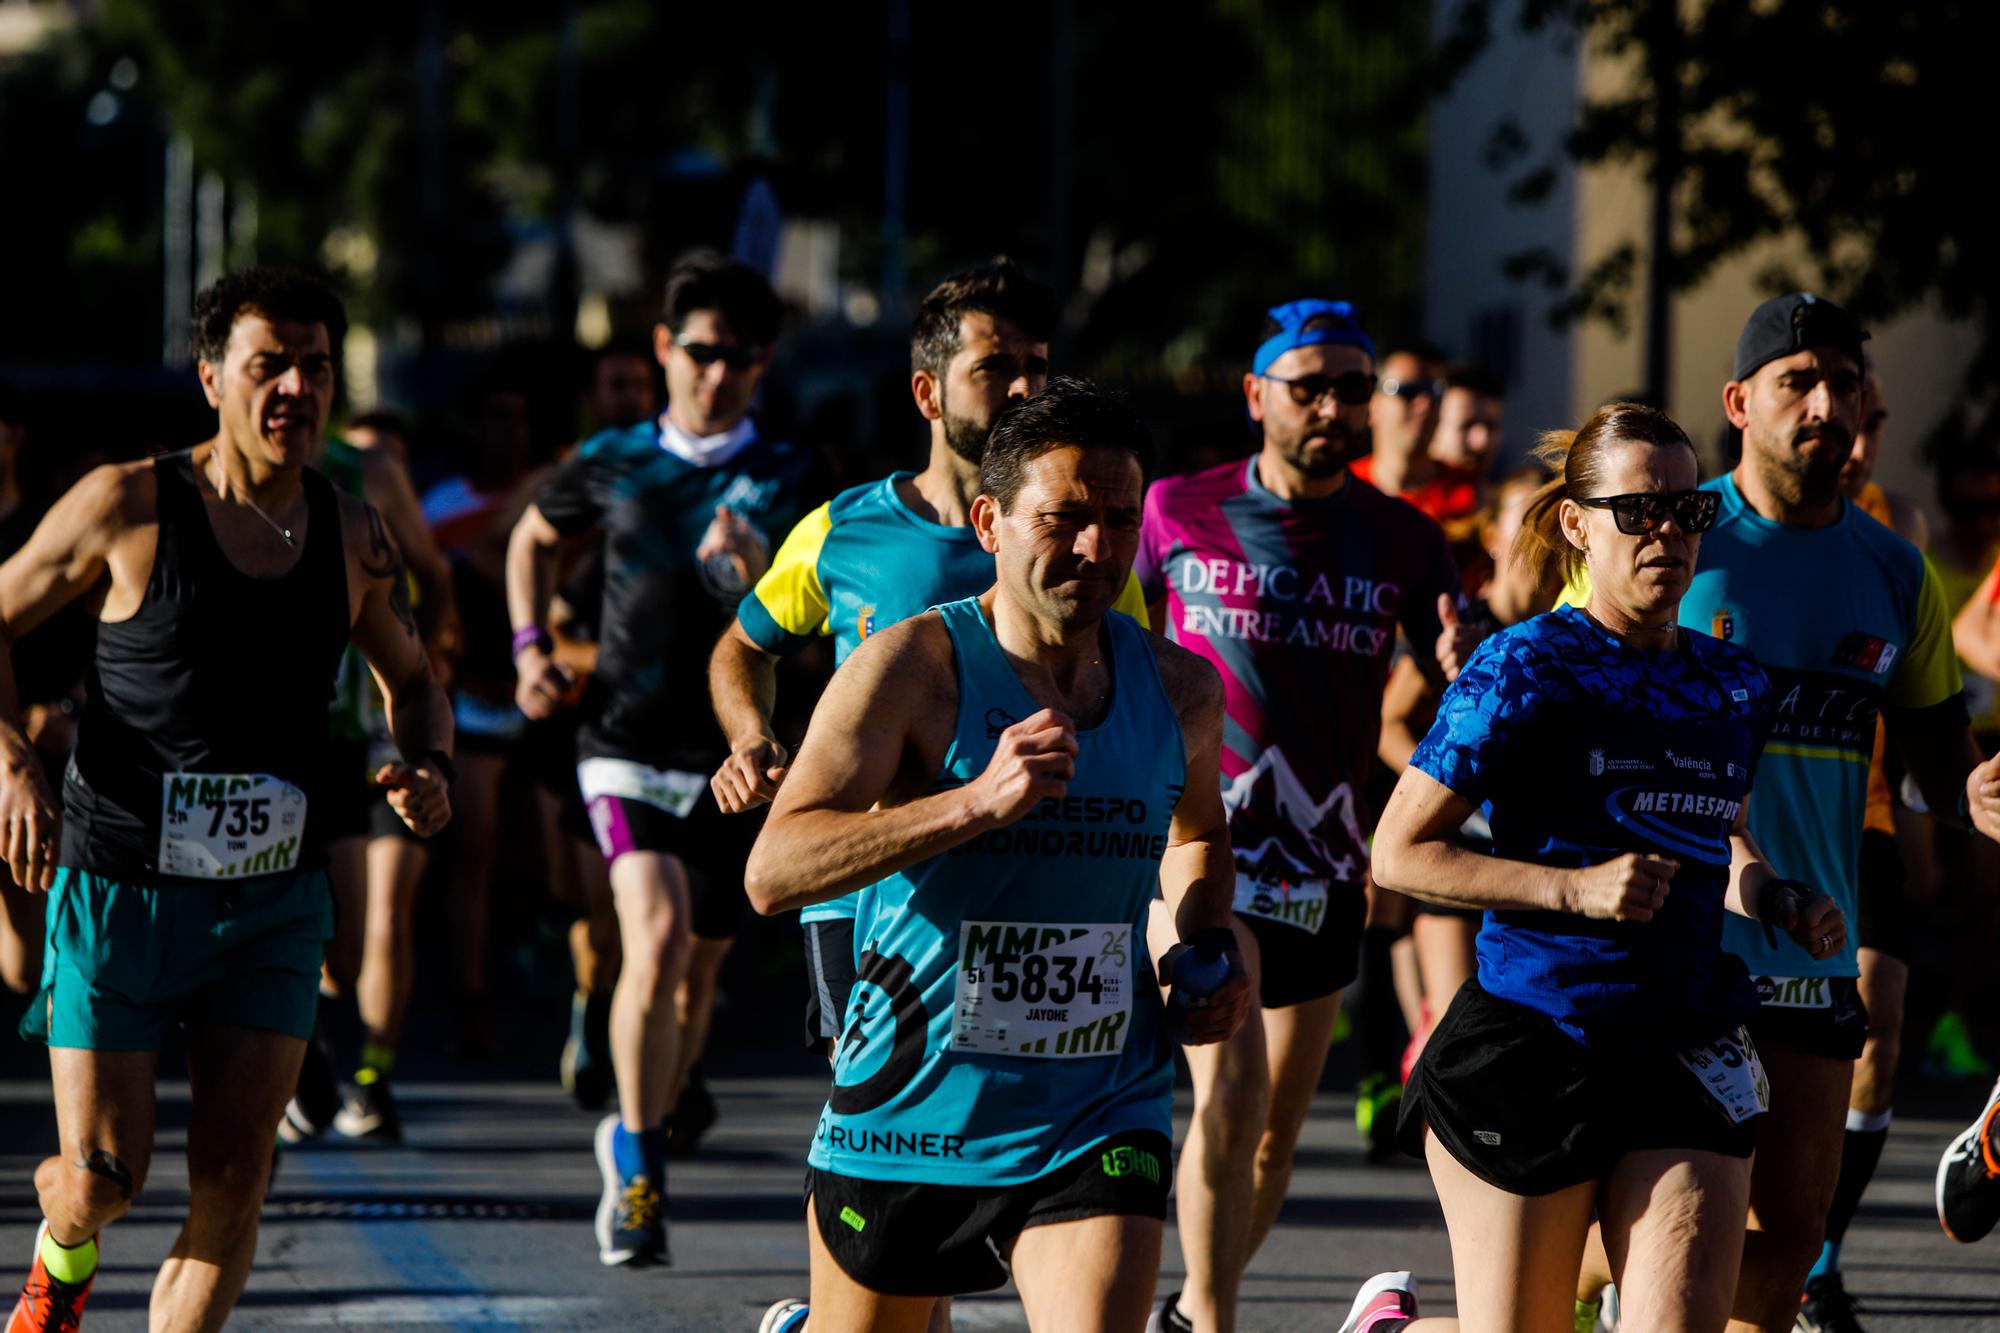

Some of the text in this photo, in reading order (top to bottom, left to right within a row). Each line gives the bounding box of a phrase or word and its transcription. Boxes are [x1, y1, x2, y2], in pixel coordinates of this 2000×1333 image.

[1182, 558, 1402, 618] DE PIC A PIC
[1800, 724, 1822, 739] DE
[1672, 755, 1712, 771] València
[205, 798, 271, 838] 735
[948, 828, 1165, 862] RONORUNNE
[991, 953, 1103, 1005] 5834
[1026, 1008, 1069, 1022] JAYOHE
[829, 1125, 966, 1159] RUNNER
